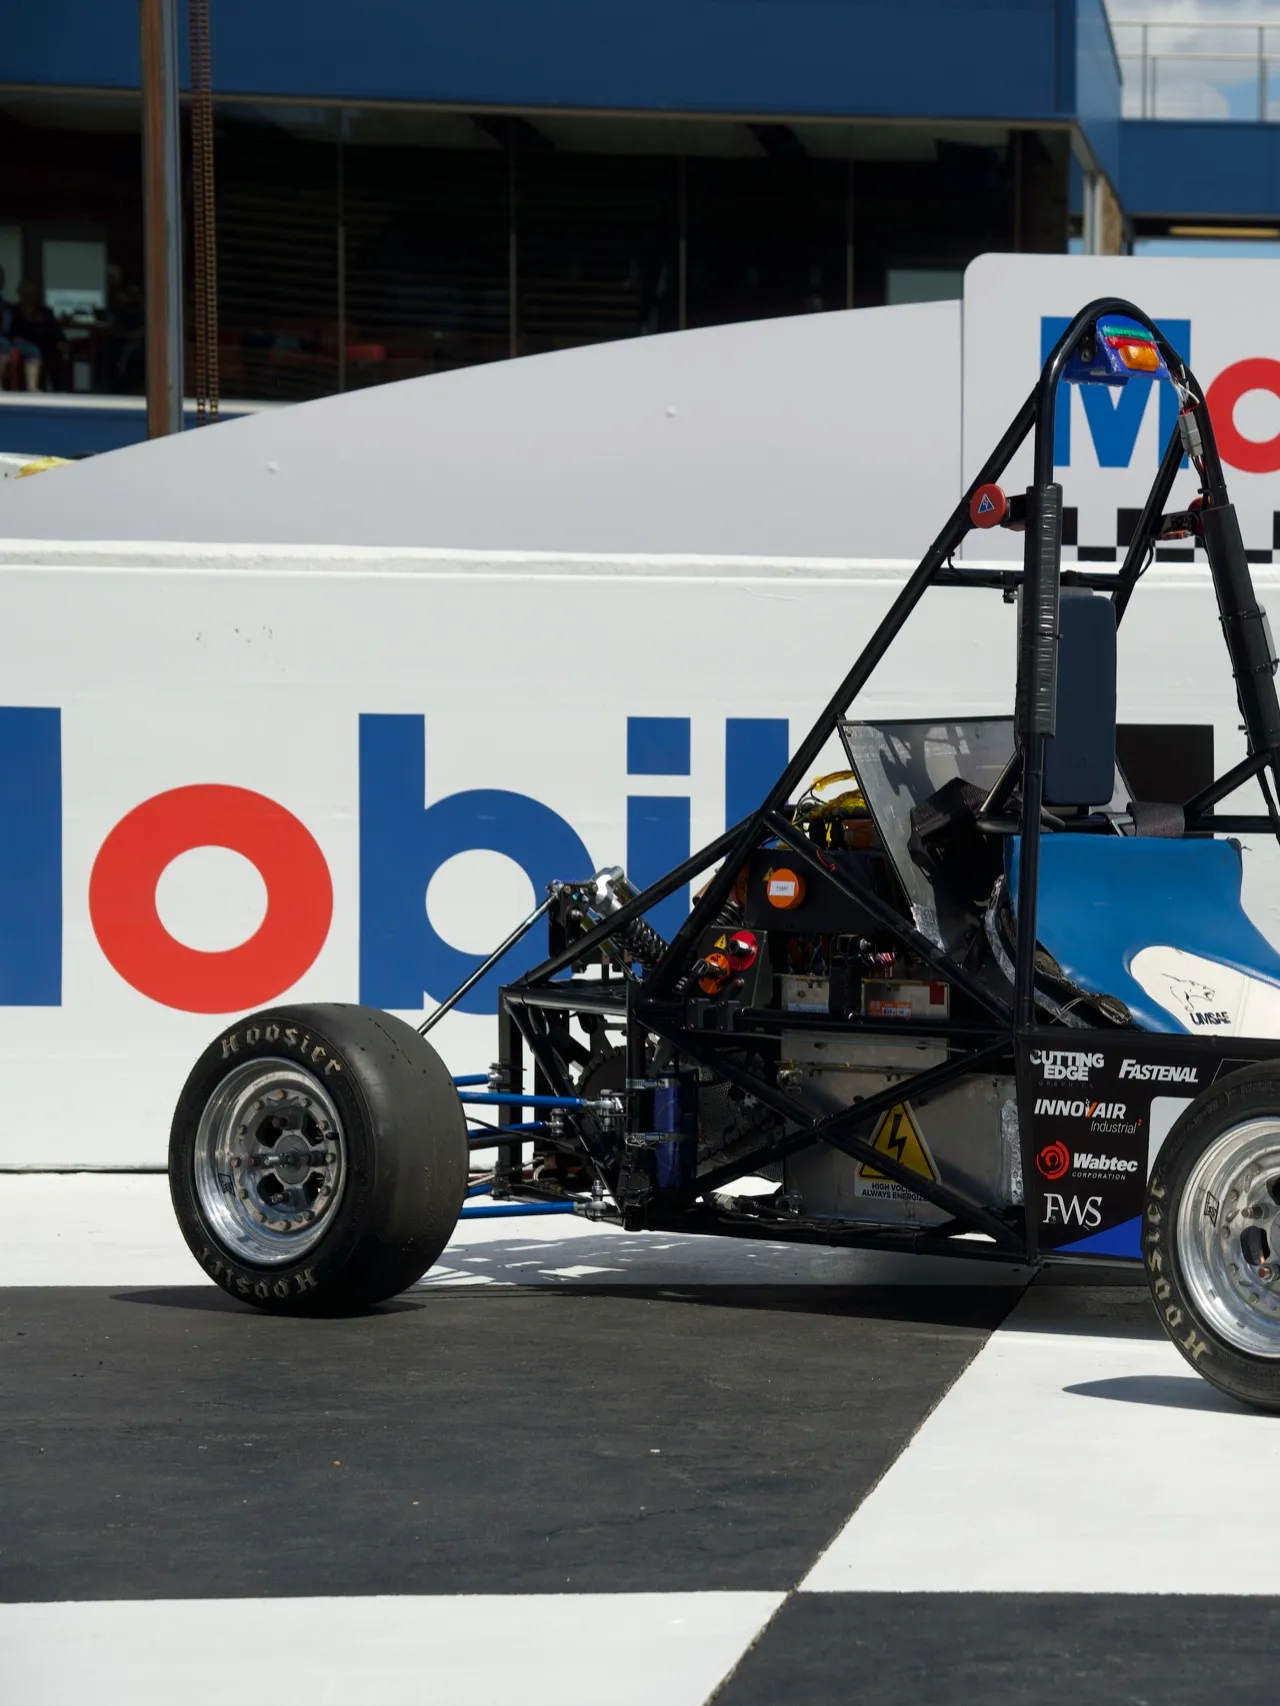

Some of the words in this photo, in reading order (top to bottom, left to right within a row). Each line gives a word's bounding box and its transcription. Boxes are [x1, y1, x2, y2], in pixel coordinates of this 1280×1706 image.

[1189, 1010, 1232, 1026] UMSAE
[1030, 1049, 1105, 1069] CUTTING
[1043, 1065, 1090, 1082] EDGE
[1118, 1059, 1199, 1083] FASTENAL
[1034, 1099, 1127, 1120] INNOVAIR
[1090, 1120, 1138, 1135] Industrial
[1073, 1153, 1139, 1173] Wabtec
[1071, 1171, 1127, 1181] CORPORATION
[861, 1189, 892, 1199] ALWAYS
[871, 1182, 890, 1191] HIGH
[1042, 1193, 1103, 1230] FWS
